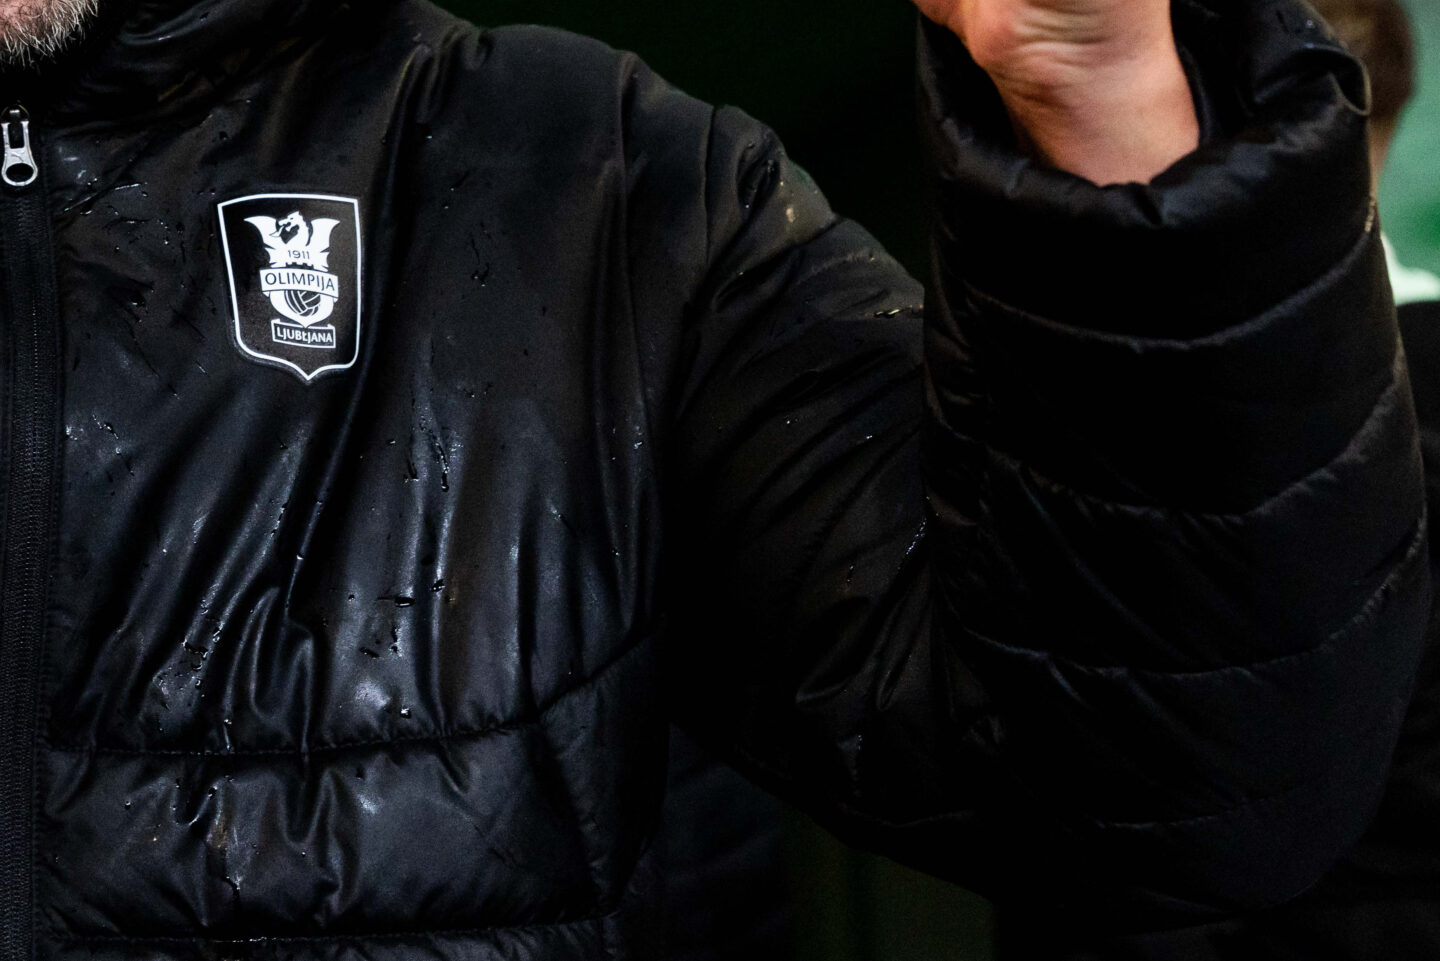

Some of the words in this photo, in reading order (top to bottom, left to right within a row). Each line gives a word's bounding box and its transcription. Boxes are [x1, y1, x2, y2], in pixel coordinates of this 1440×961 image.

[288, 250, 310, 259] 1911
[264, 272, 335, 291] OLIMPIJA
[276, 326, 333, 344] LJUBLJANA
